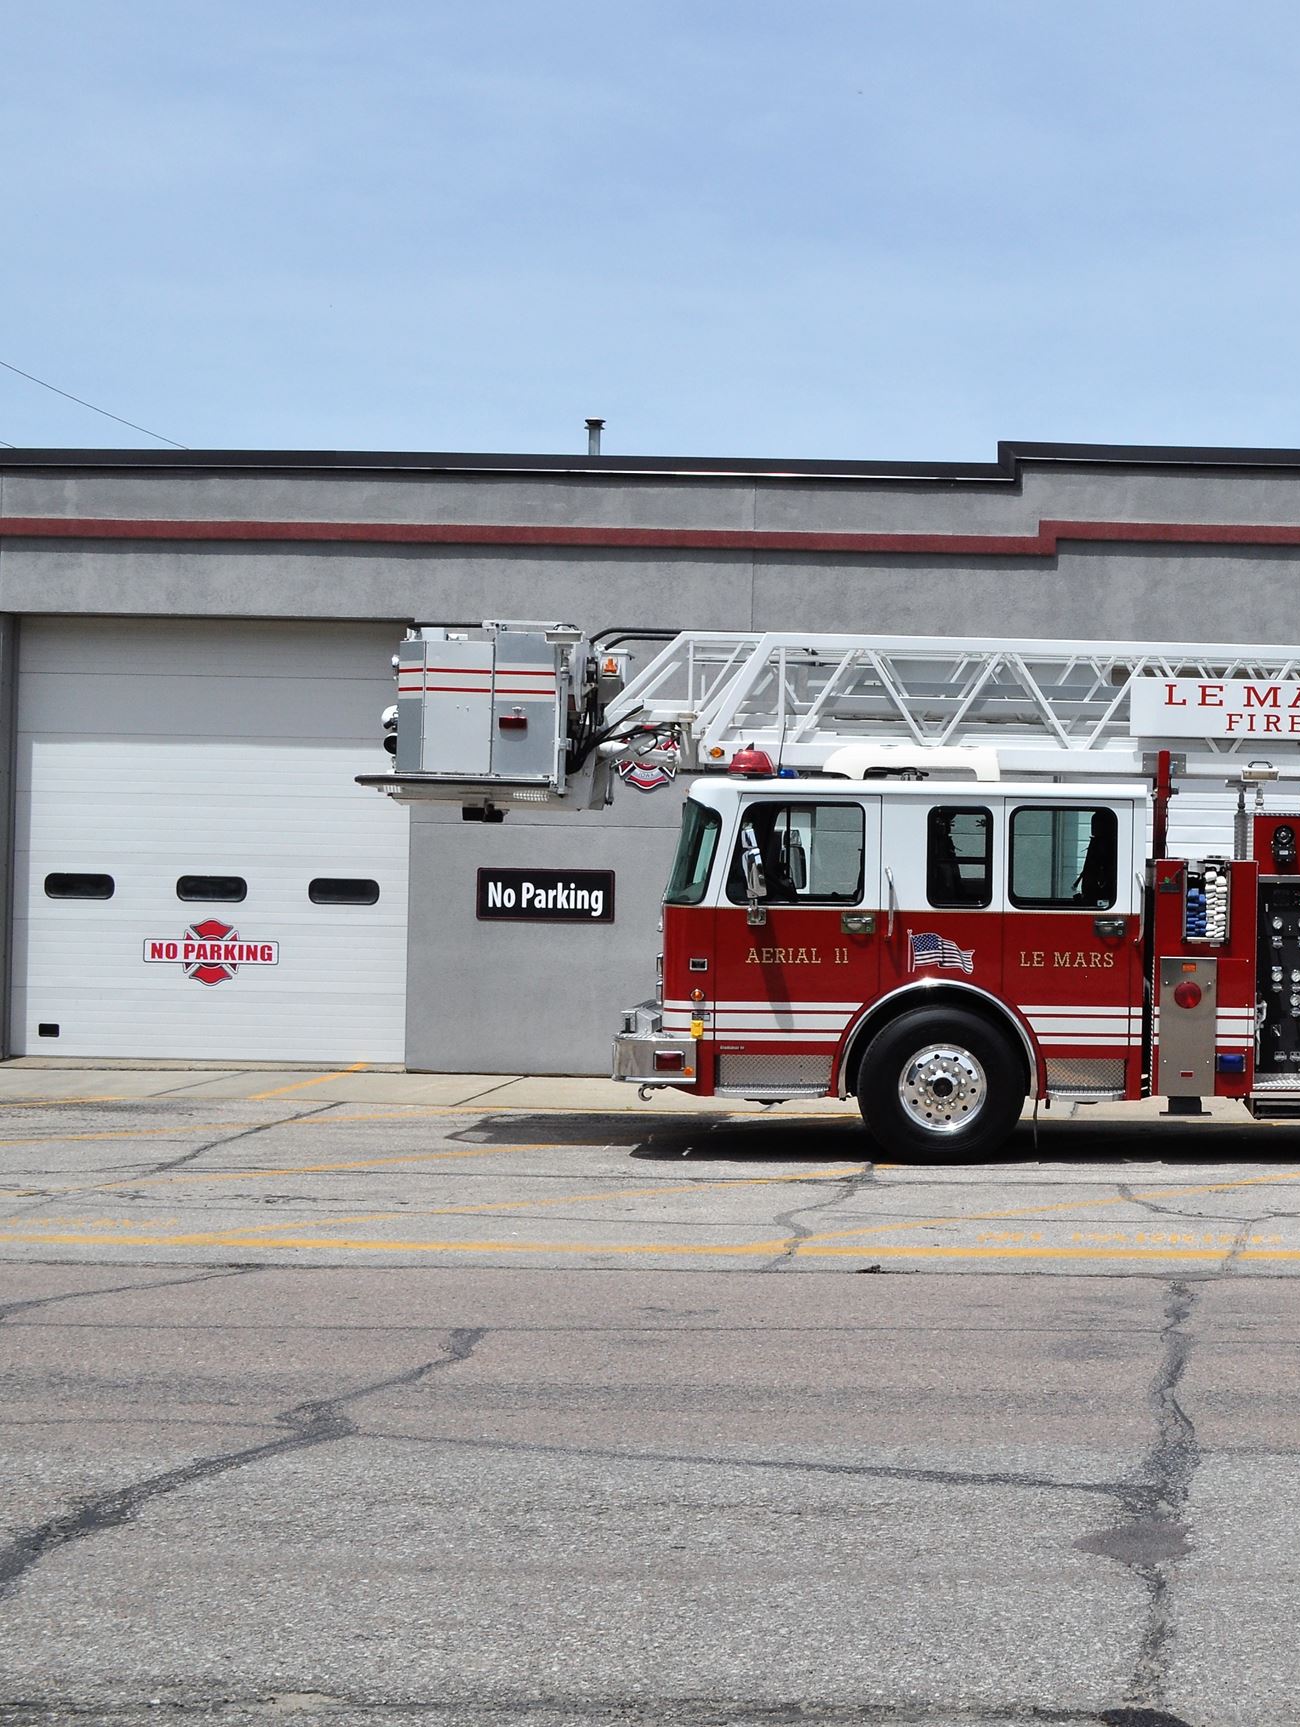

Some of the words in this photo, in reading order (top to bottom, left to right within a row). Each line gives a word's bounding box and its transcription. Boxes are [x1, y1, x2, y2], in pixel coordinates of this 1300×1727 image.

[1164, 684, 1224, 706] LE
[487, 881, 516, 908] No
[521, 882, 604, 917] Parking
[150, 942, 178, 960] NO
[183, 943, 273, 962] PARKING
[745, 947, 822, 964] AERIAL
[1020, 951, 1045, 967] LE
[1053, 951, 1114, 968] MARS
